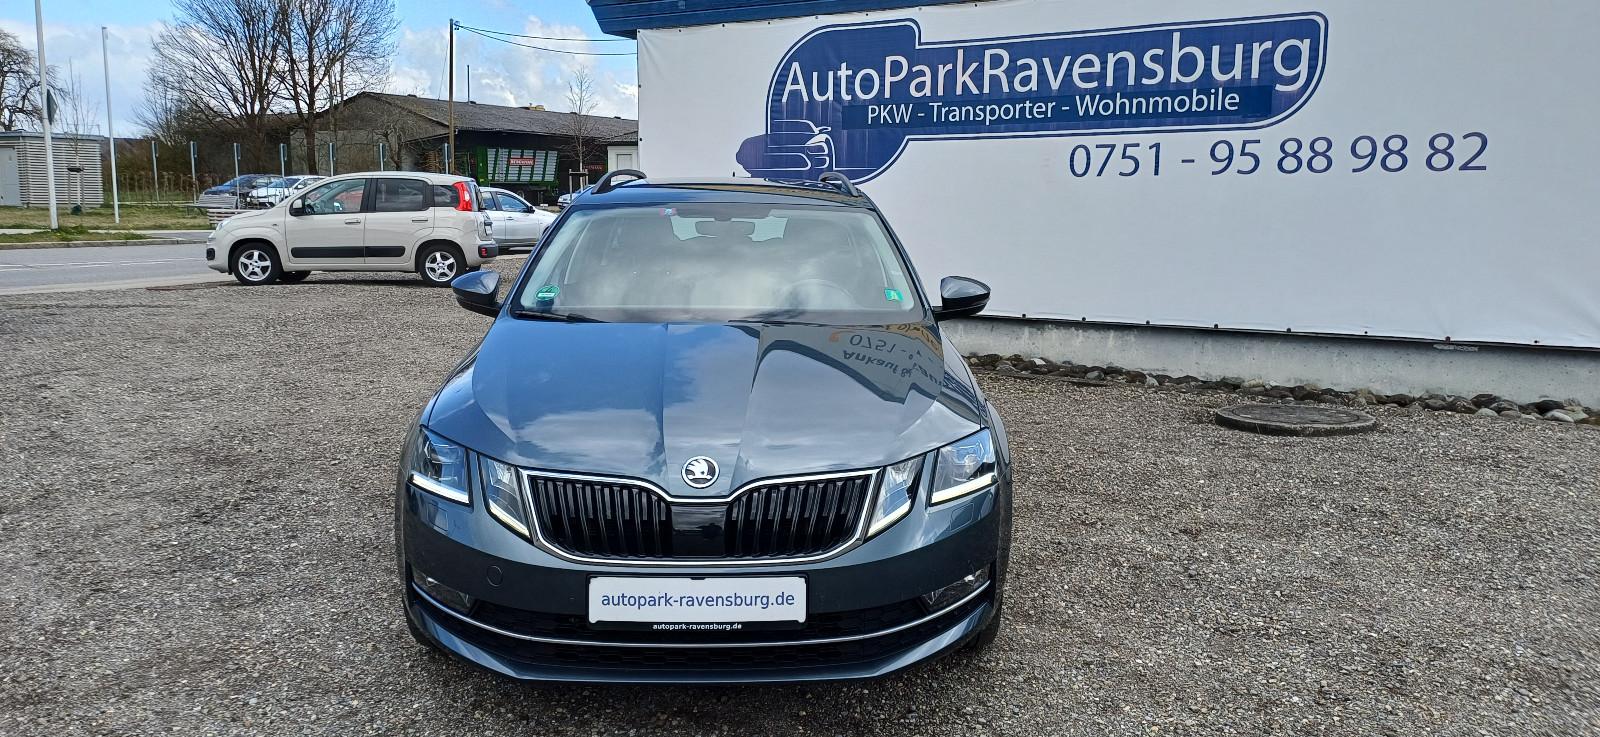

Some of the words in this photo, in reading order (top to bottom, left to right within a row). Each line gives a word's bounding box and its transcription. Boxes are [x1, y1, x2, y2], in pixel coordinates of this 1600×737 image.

[782, 32, 1311, 103] AutoParkRavensburg
[867, 104, 913, 125] PKW
[929, 99, 1056, 125] Transporter
[1075, 88, 1240, 116] Wohnmobile
[1068, 142, 1162, 177] 0751
[1209, 139, 1261, 176] 95
[1276, 136, 1333, 174] 88
[1350, 134, 1408, 173] 98
[1425, 131, 1489, 172] 82
[601, 592, 795, 610] autopark-ravensburg.de
